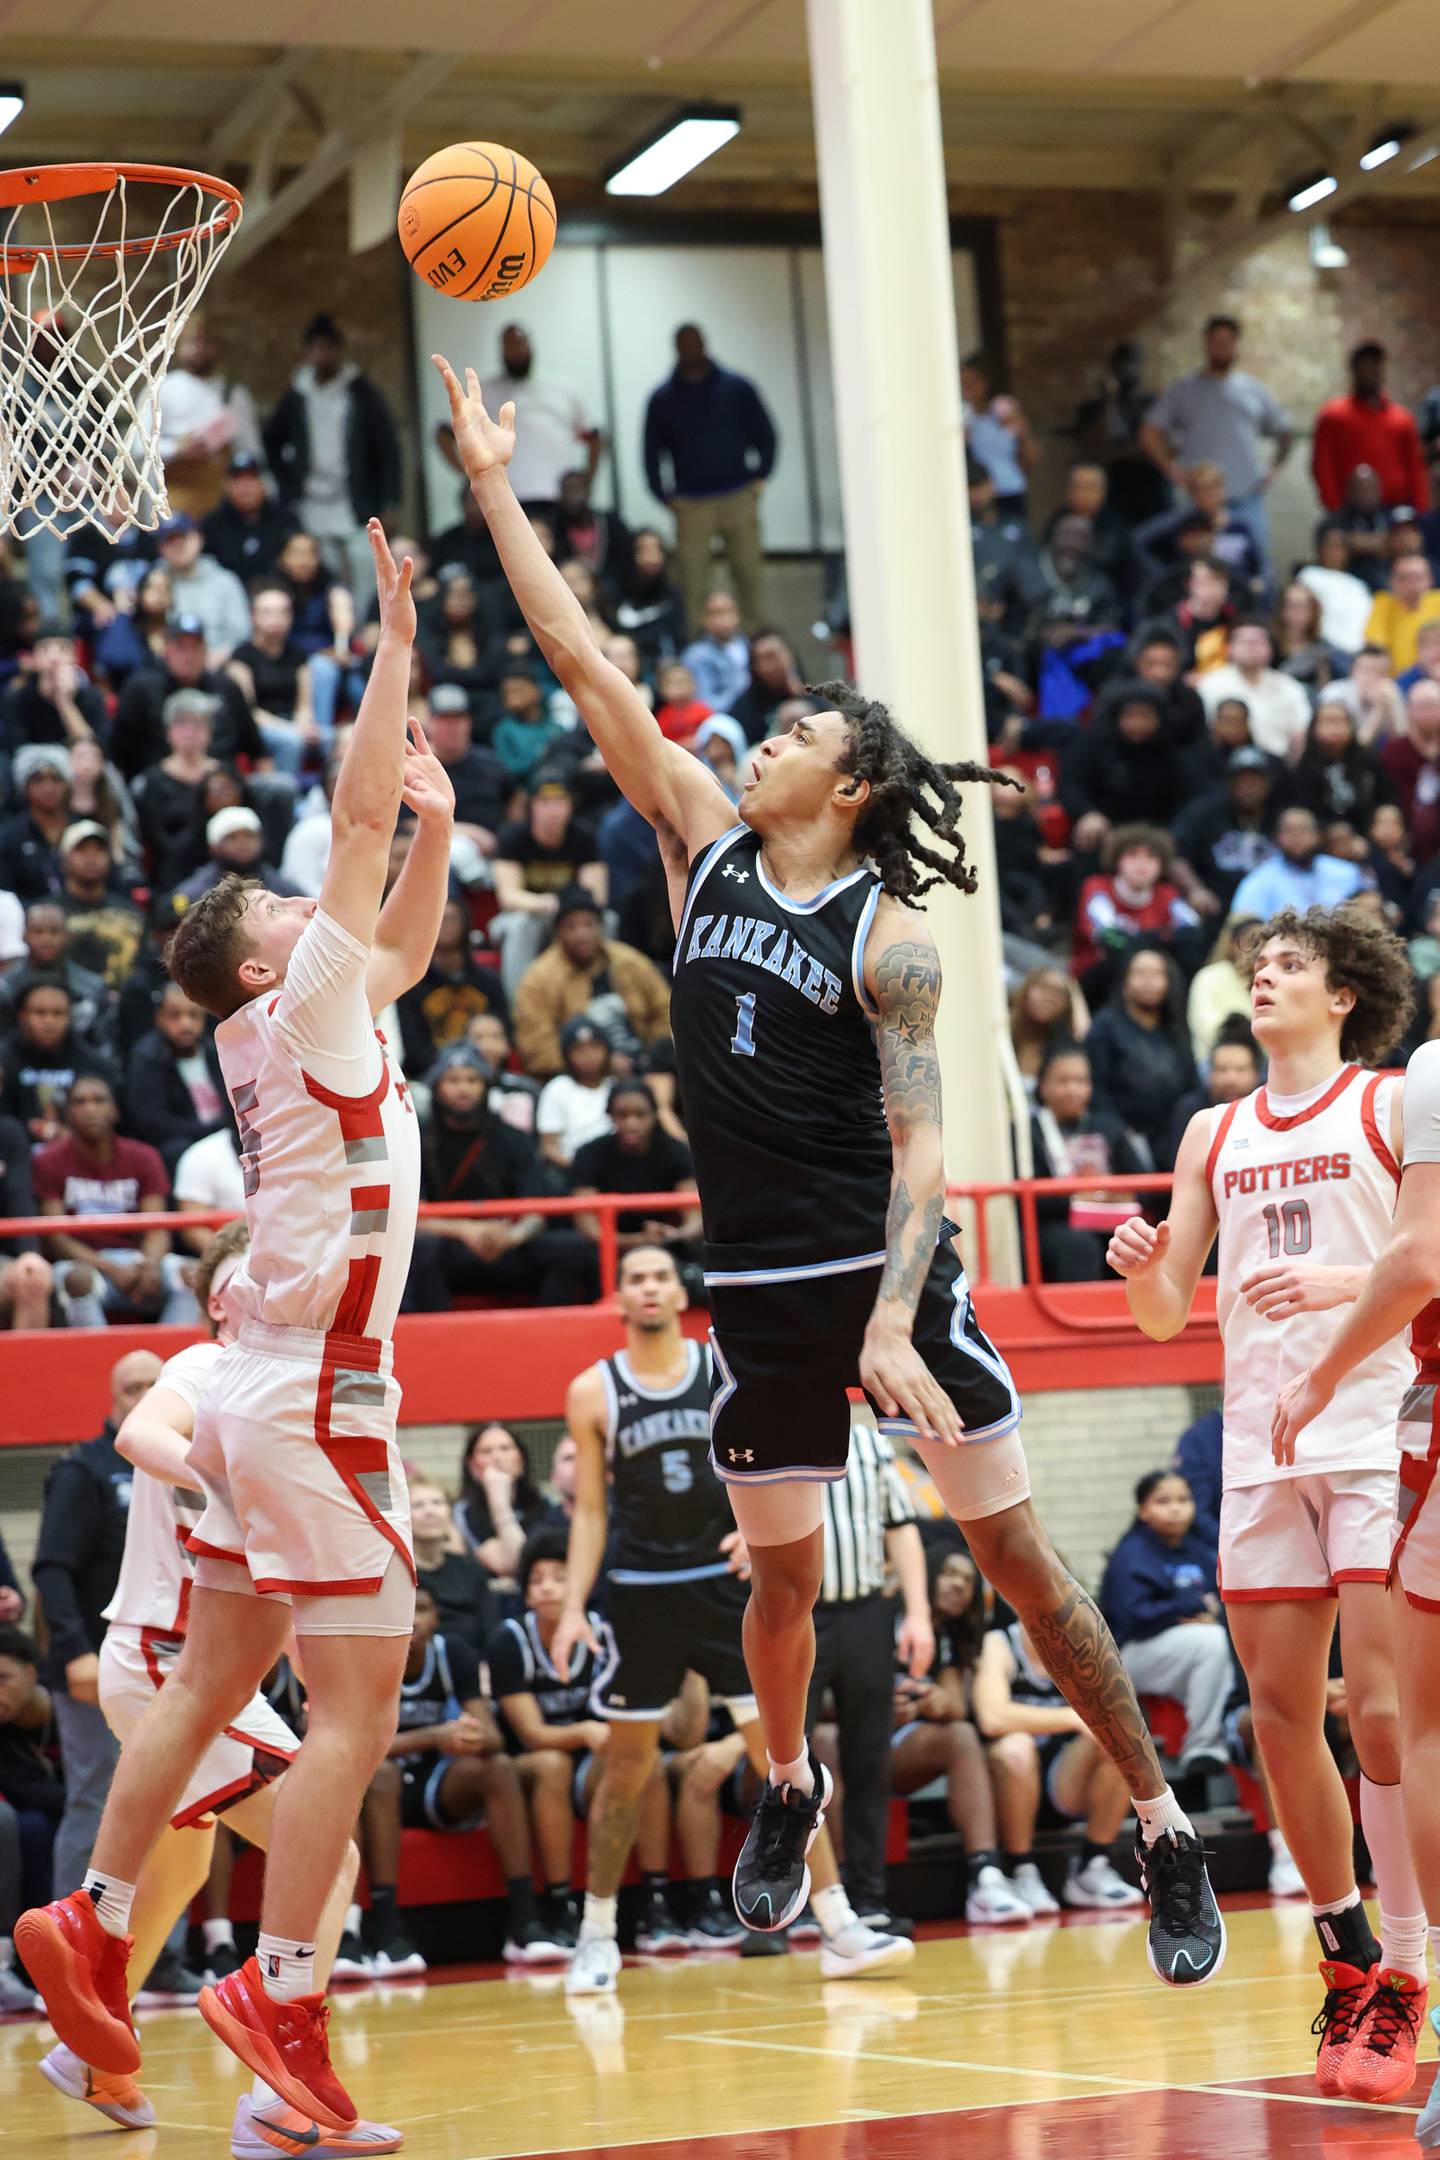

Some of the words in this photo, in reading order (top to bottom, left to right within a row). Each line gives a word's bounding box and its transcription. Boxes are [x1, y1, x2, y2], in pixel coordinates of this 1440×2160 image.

[685, 914, 842, 1016] KANKAKEE
[730, 991, 757, 1057] 1
[1223, 1152, 1351, 1200] POTTERS
[1262, 1198, 1312, 1259] 10
[660, 1449, 694, 1493] 5
